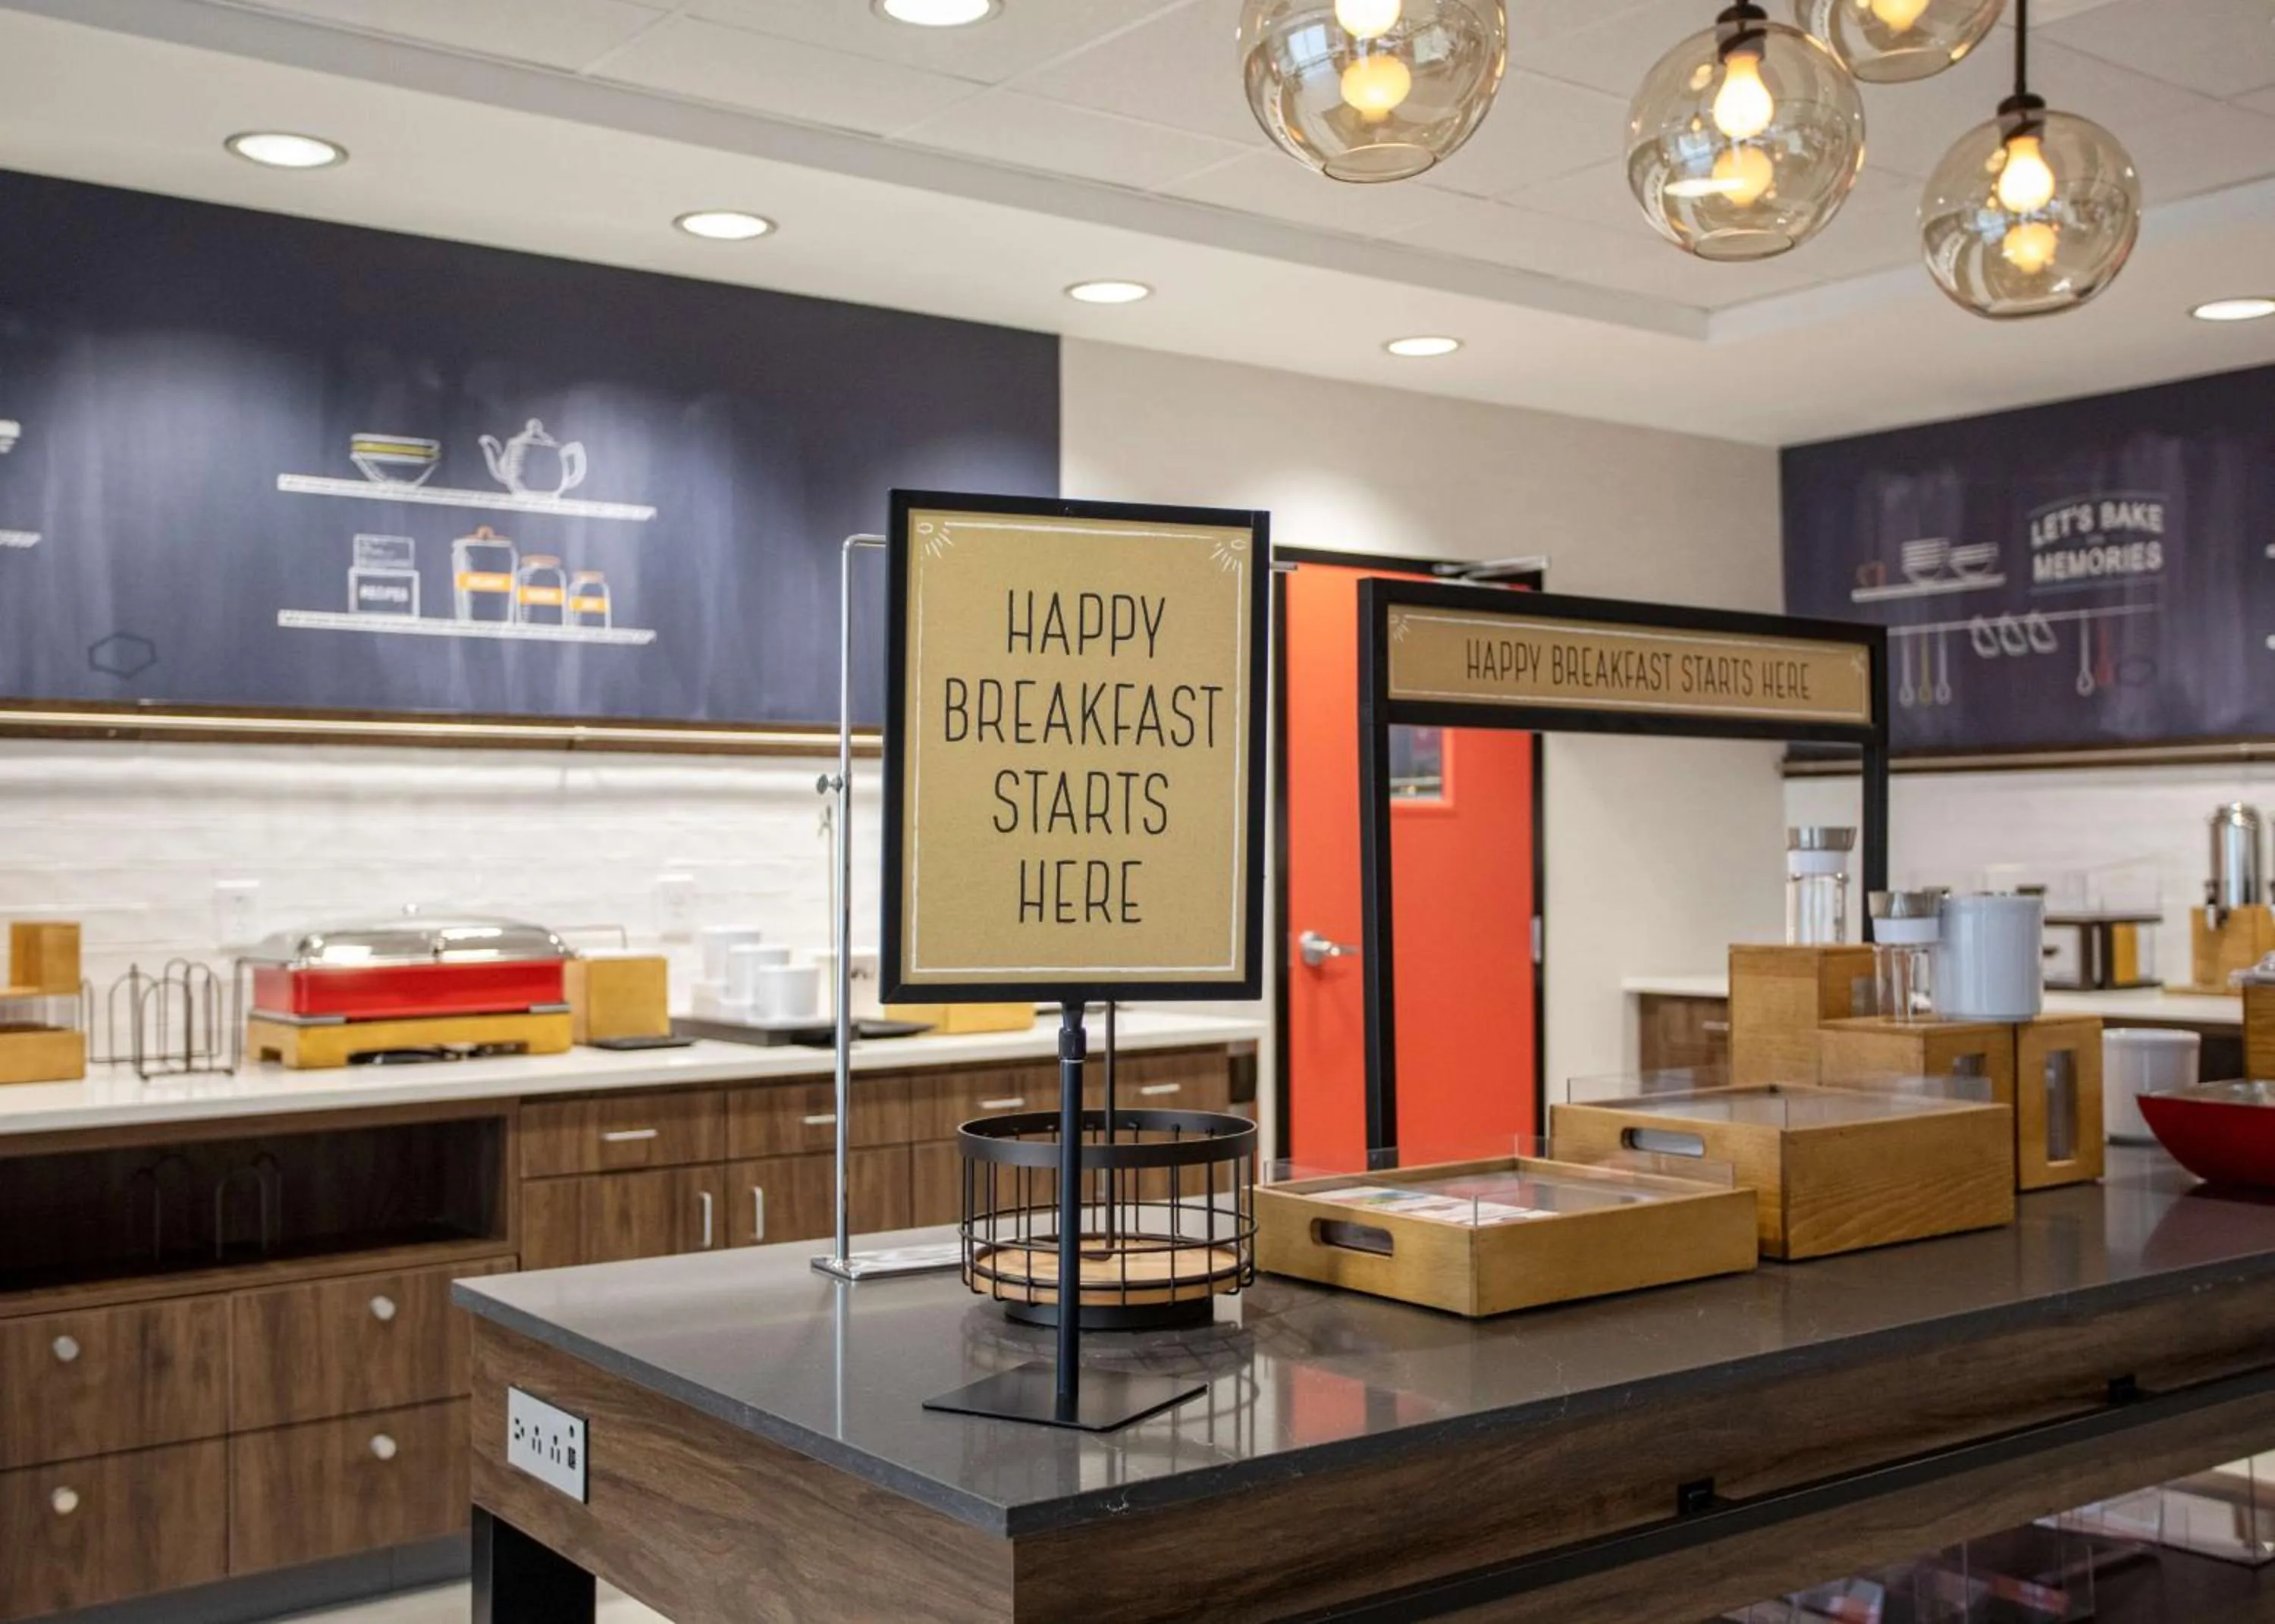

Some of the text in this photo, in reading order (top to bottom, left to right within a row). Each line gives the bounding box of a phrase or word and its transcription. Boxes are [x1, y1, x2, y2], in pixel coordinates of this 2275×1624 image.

[2031, 501, 2164, 549] LET'S BAKE
[2033, 541, 2164, 583] MEMORIES
[1008, 589, 1166, 658] HAPPY
[1467, 639, 1811, 700] HAPPY BREAKFAST STARTS HERE
[945, 677, 1223, 748] BREAKFAST
[993, 769, 1169, 836] STARTS
[1018, 859, 1142, 923] HERE
